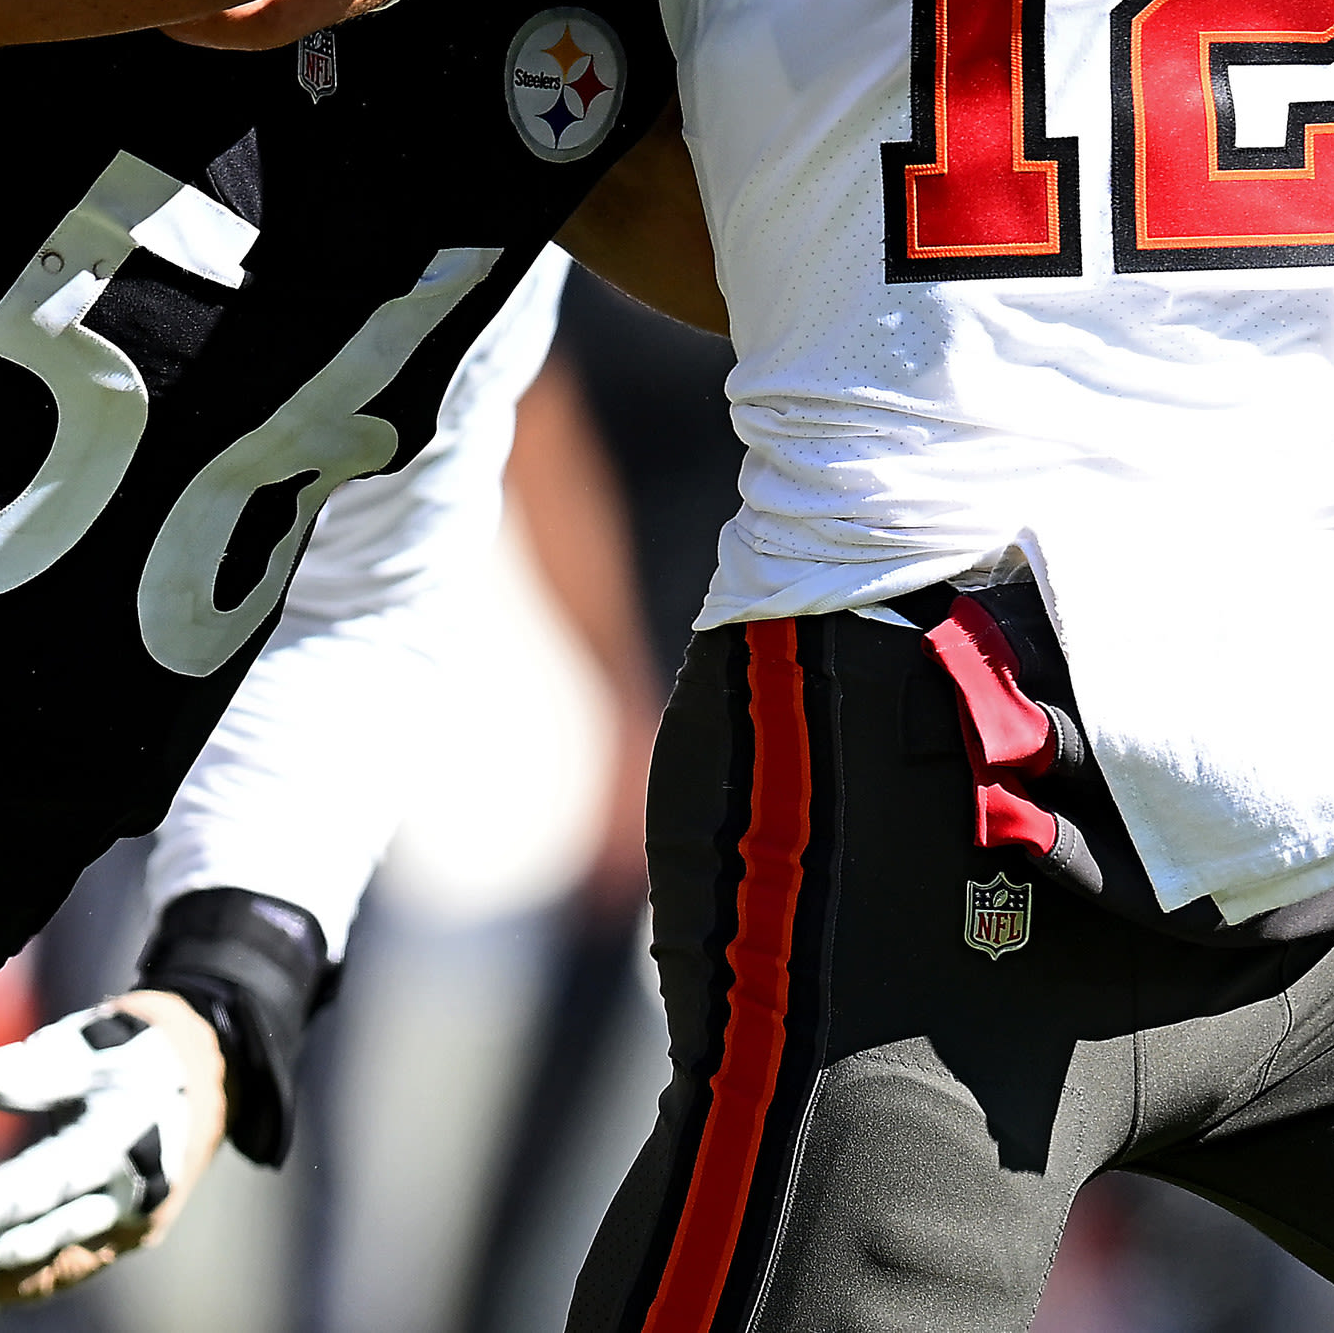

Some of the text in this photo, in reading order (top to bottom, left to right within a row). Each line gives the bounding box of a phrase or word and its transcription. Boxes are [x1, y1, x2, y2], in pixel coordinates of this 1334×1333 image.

[305, 52, 333, 85] NFL
[514, 68, 561, 90] Steelers
[975, 912, 1022, 945] NFL
